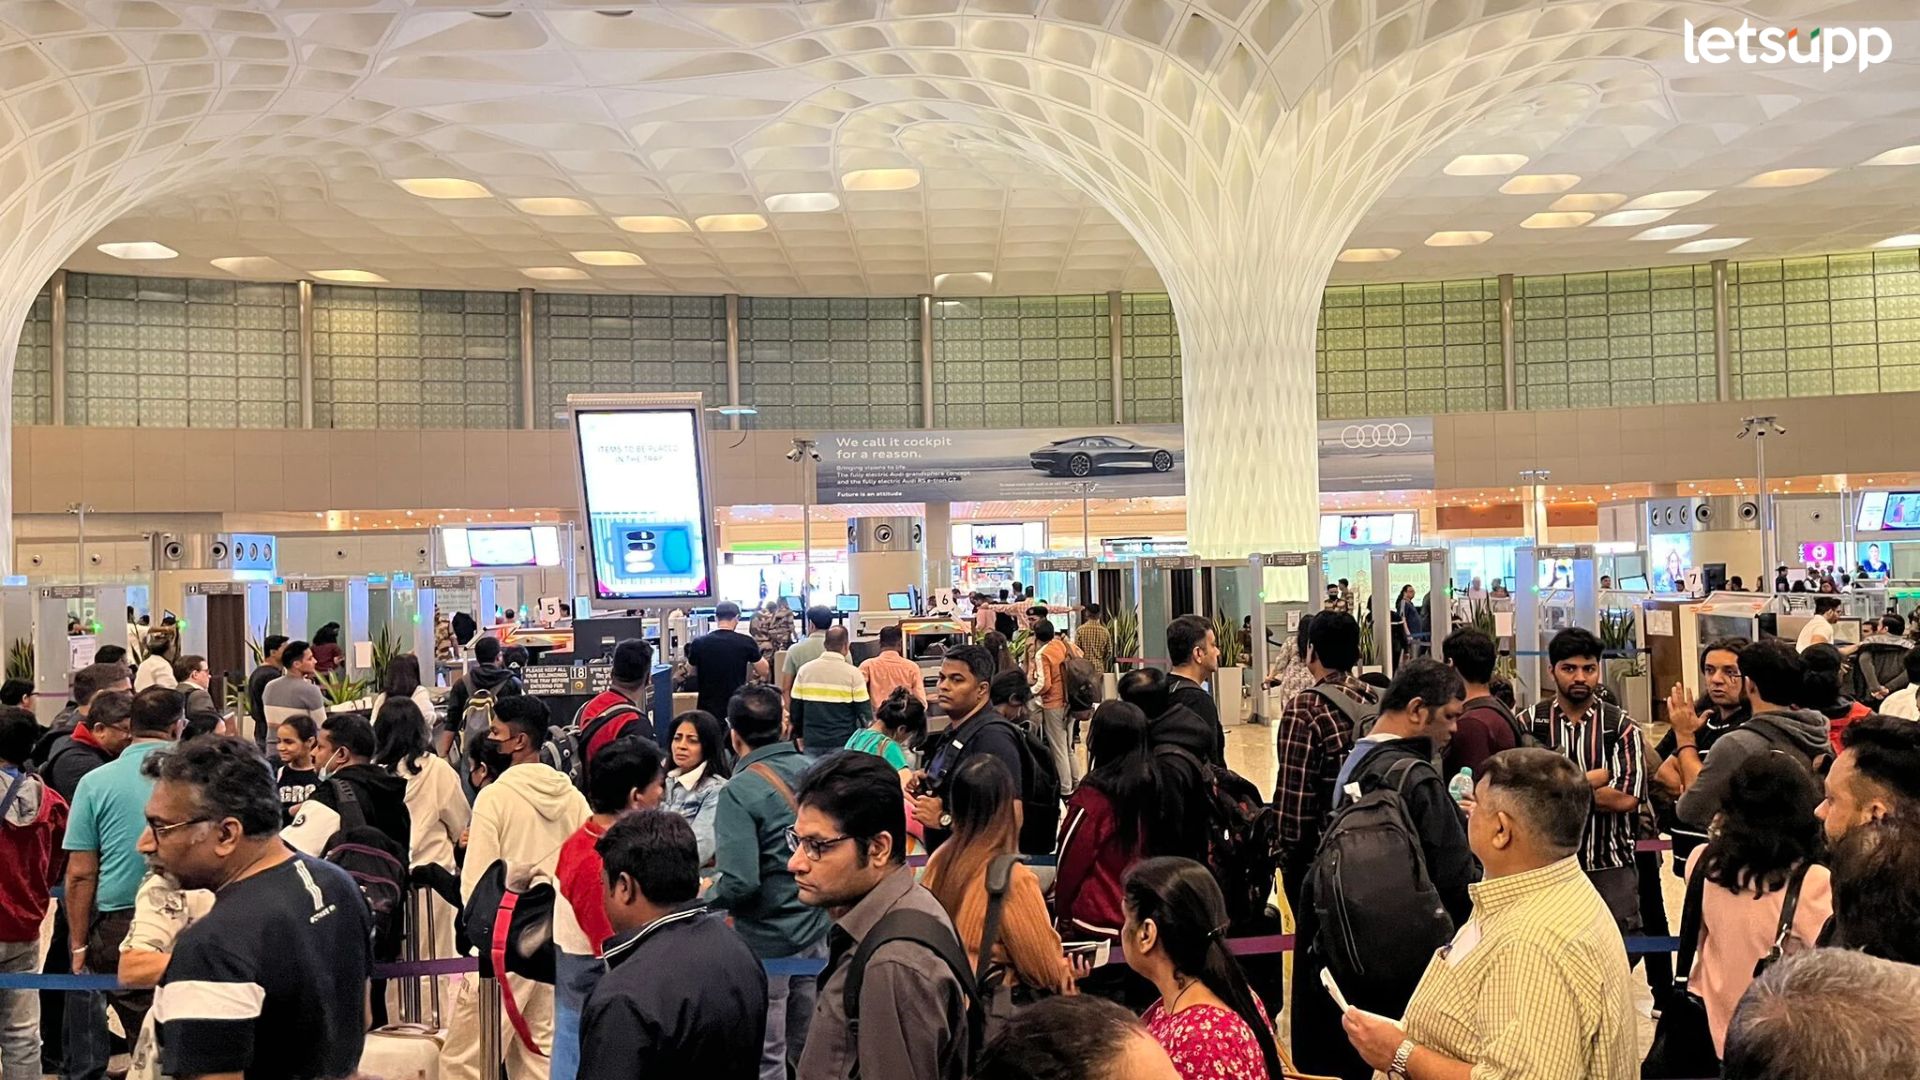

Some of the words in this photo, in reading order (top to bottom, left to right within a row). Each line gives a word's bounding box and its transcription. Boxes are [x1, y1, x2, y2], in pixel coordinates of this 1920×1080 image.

[836, 437, 859, 447] We
[862, 436, 886, 447] call
[890, 436, 900, 447] it
[903, 436, 952, 448] cockpit
[836, 449, 857, 459] for
[860, 451, 868, 459] a
[872, 450, 922, 459] reason.
[1689, 573, 1697, 585] 7
[941, 594, 949, 605] 6
[547, 604, 555, 615] 5
[572, 667, 585, 678] 18
